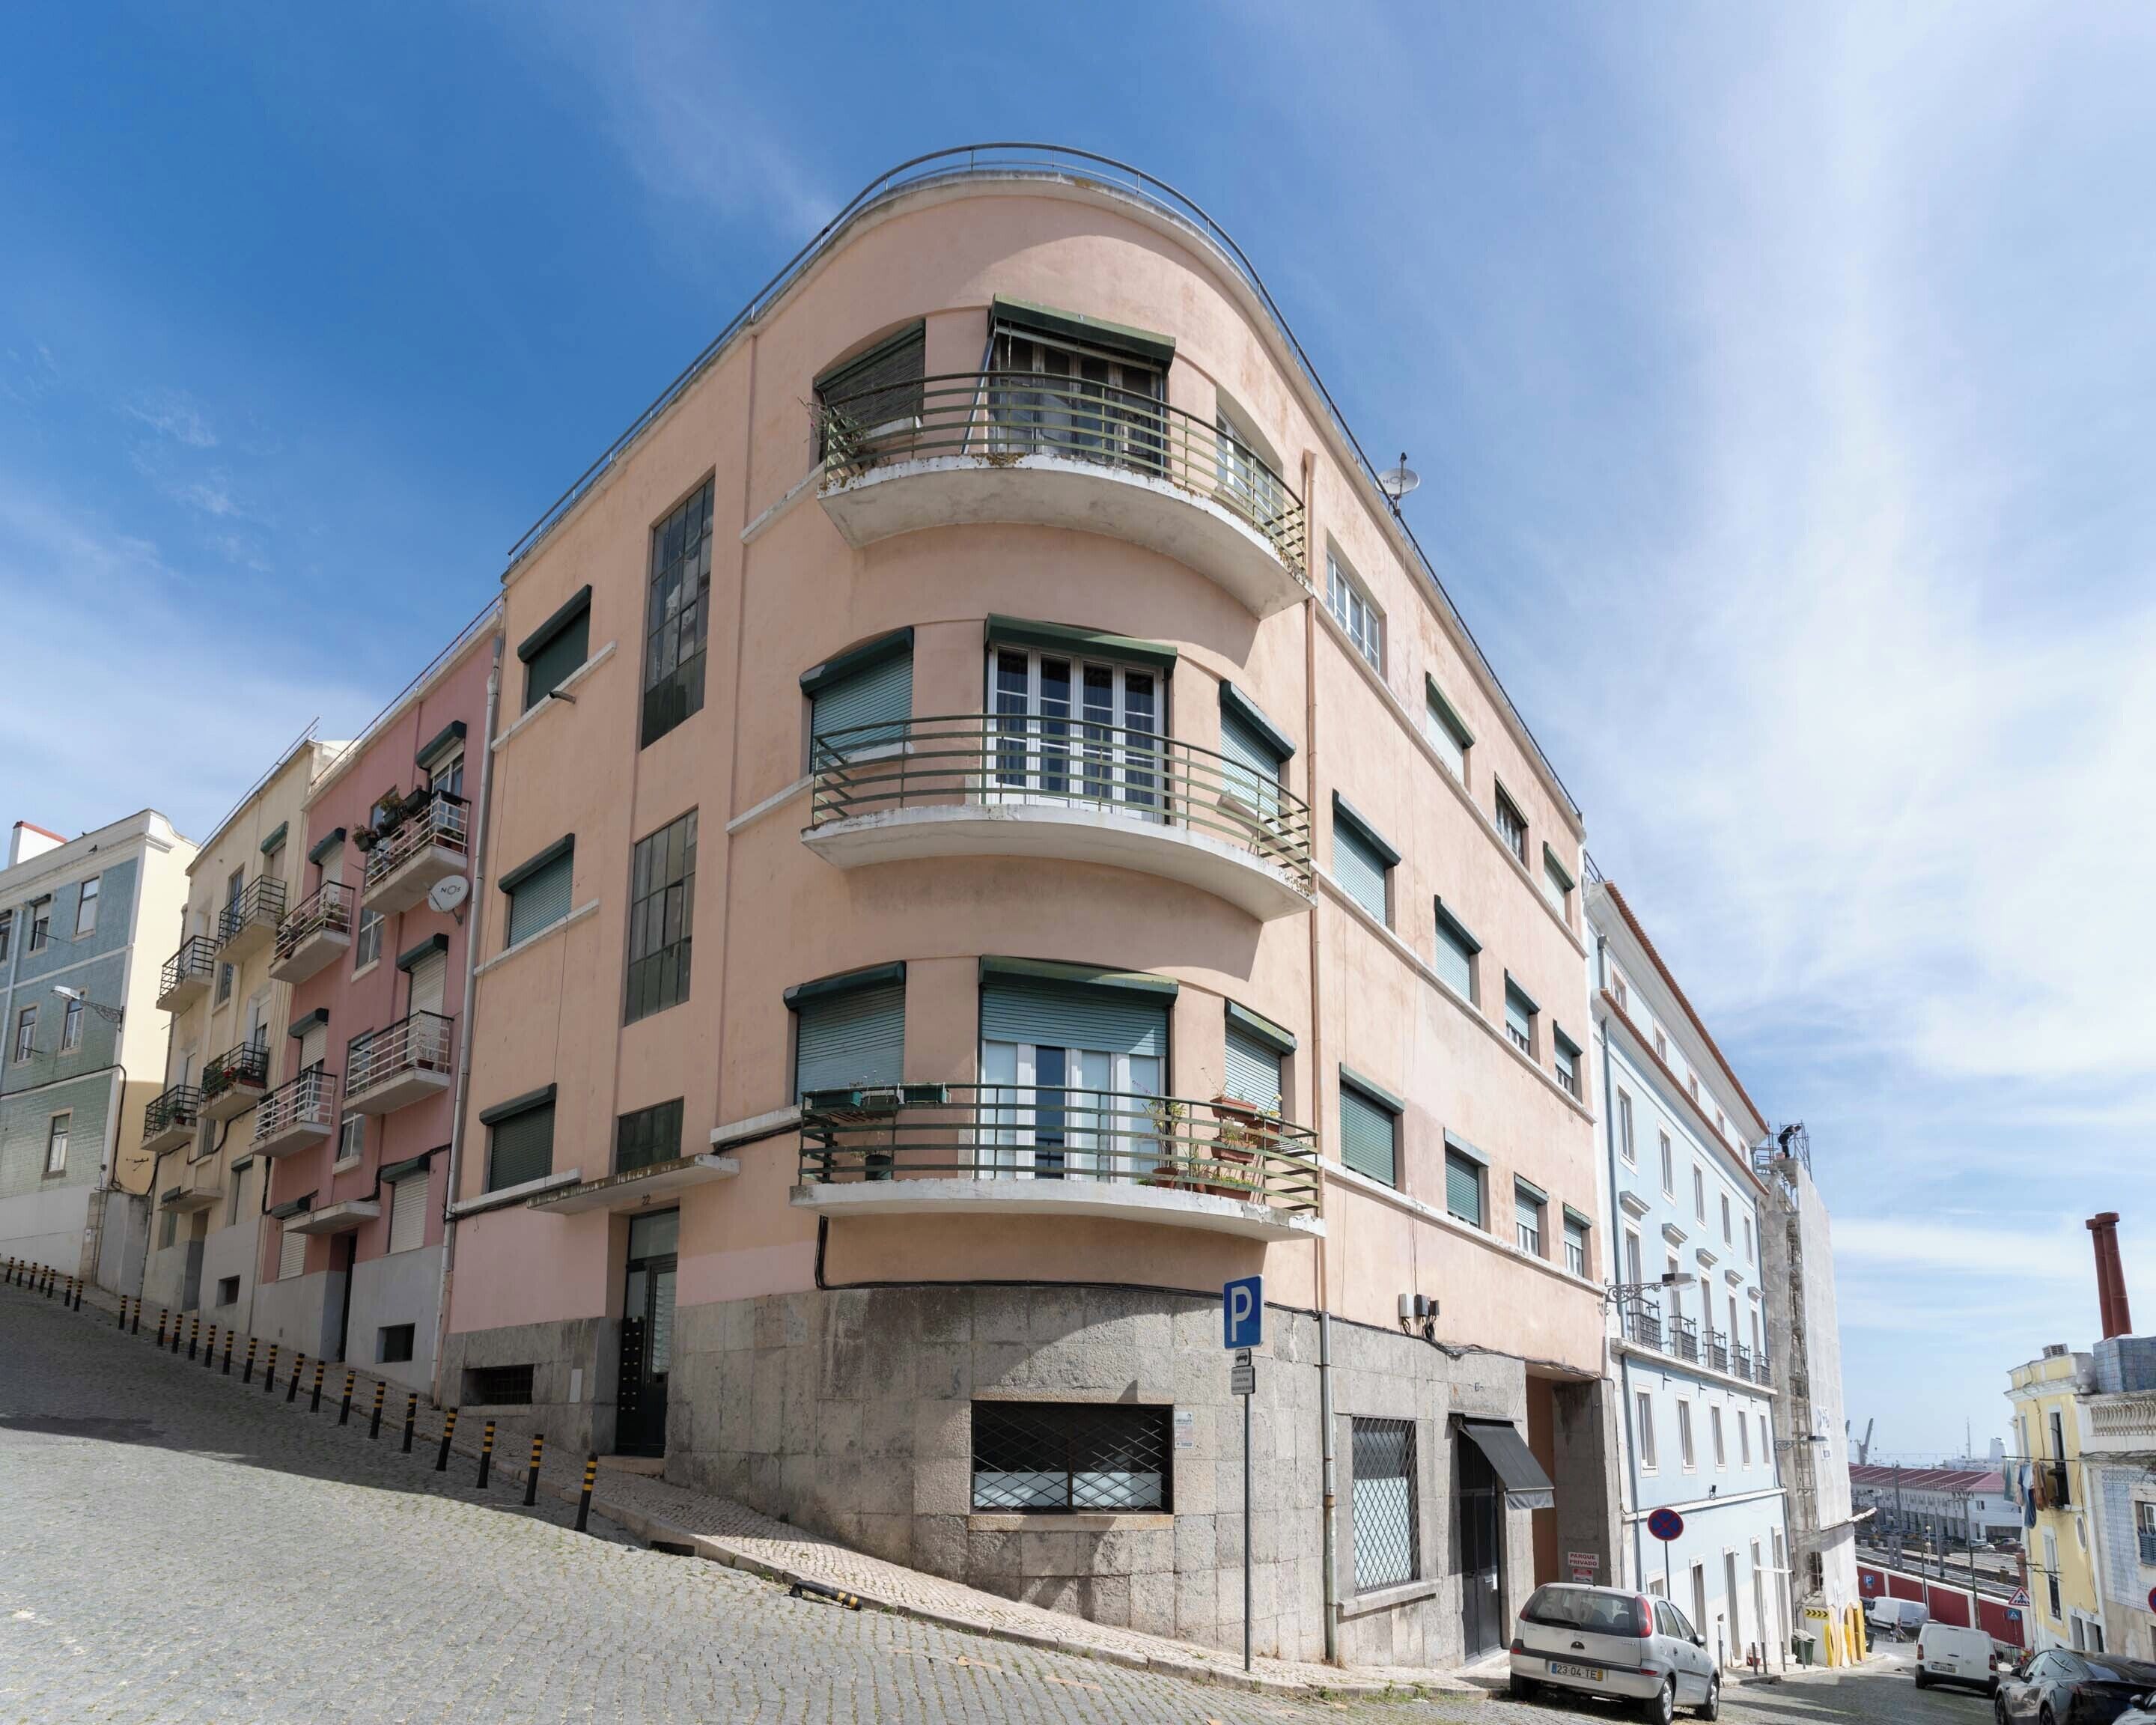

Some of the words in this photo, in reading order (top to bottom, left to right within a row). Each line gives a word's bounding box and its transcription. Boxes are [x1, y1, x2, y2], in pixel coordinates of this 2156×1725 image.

[441, 885, 461, 895] NOS
[1231, 1286, 1252, 1342] P
[1866, 1576, 1872, 1585] P
